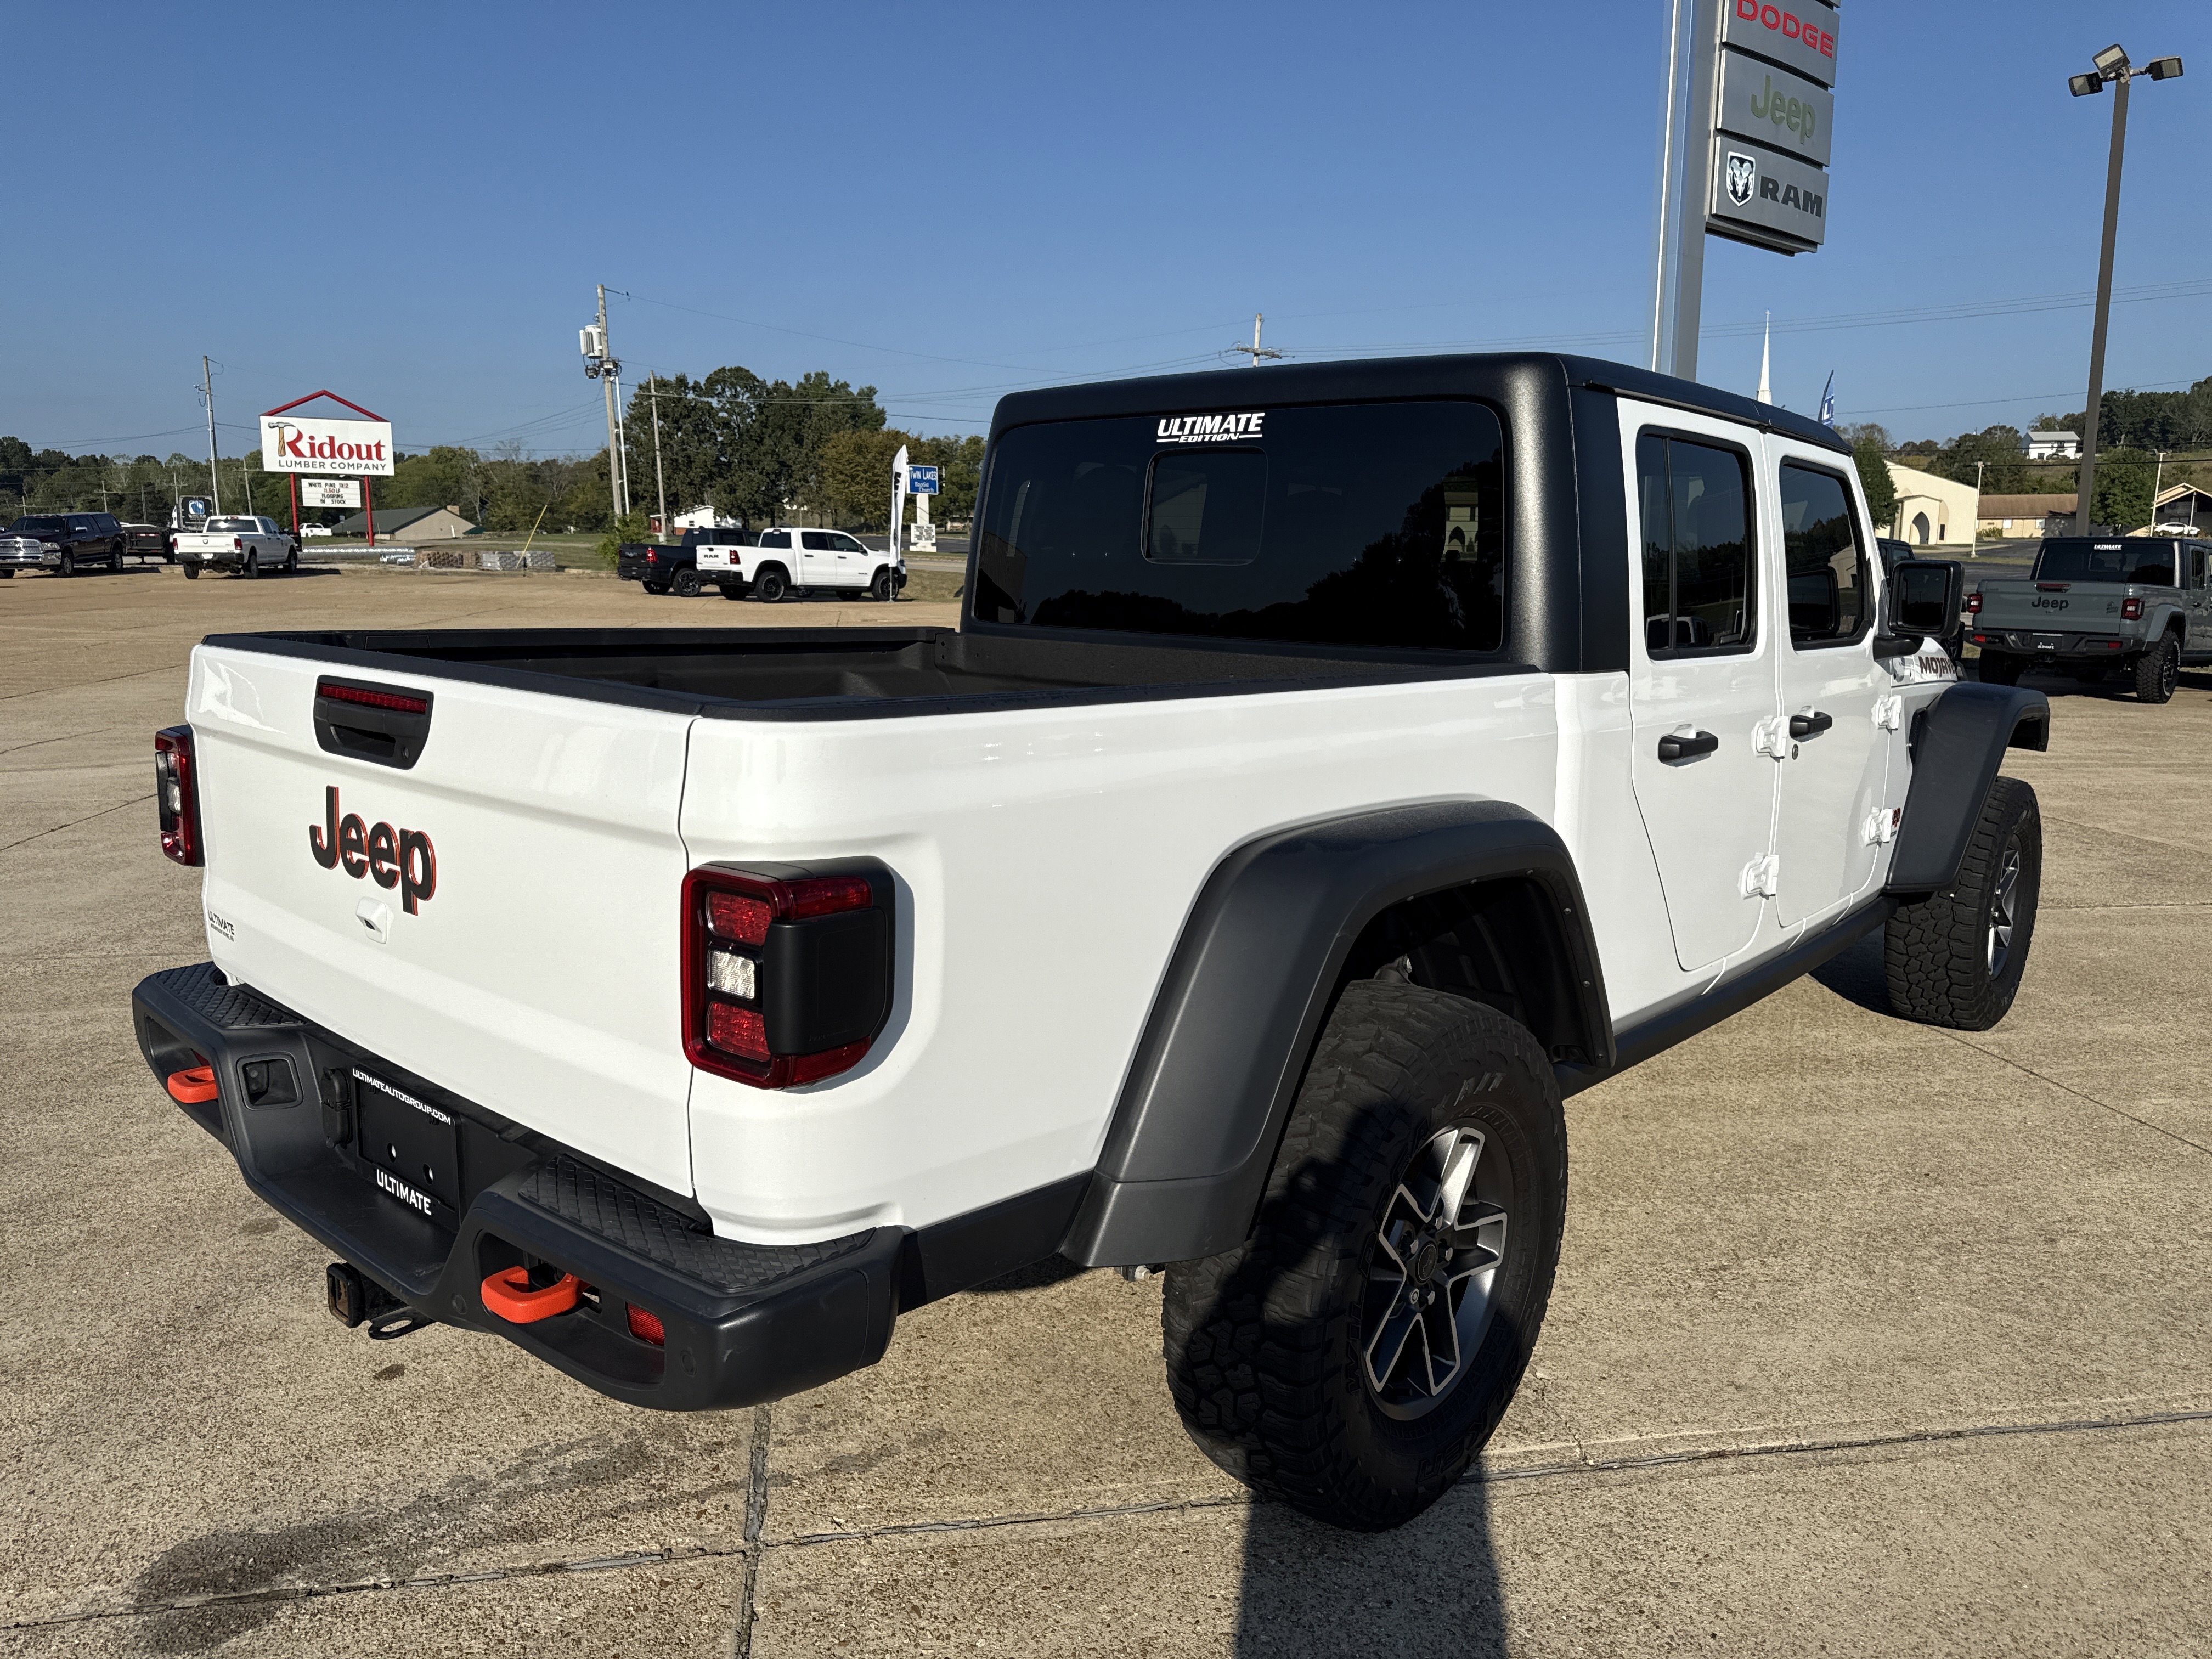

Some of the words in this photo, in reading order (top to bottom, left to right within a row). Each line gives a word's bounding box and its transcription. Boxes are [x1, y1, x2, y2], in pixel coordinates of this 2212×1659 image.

[1736, 0, 1833, 58] DODGE
[1751, 74, 1816, 144] Jeep
[1759, 175, 1823, 218] RAM
[268, 422, 386, 461] Ridout
[1157, 413, 1265, 436] ULTIMATE
[1178, 433, 1239, 443] EDITION
[279, 460, 326, 469] LUMBER
[330, 462, 386, 471] COMPANY
[2032, 596, 2069, 611] Jeep
[1918, 656, 1956, 678] MOJAV
[309, 785, 437, 916] Jeep
[208, 909, 235, 936] ULTIMATE
[352, 1068, 451, 1126] ULTIMATEAUTOGROUP.COM
[376, 1169, 432, 1216] ULTIMATE
